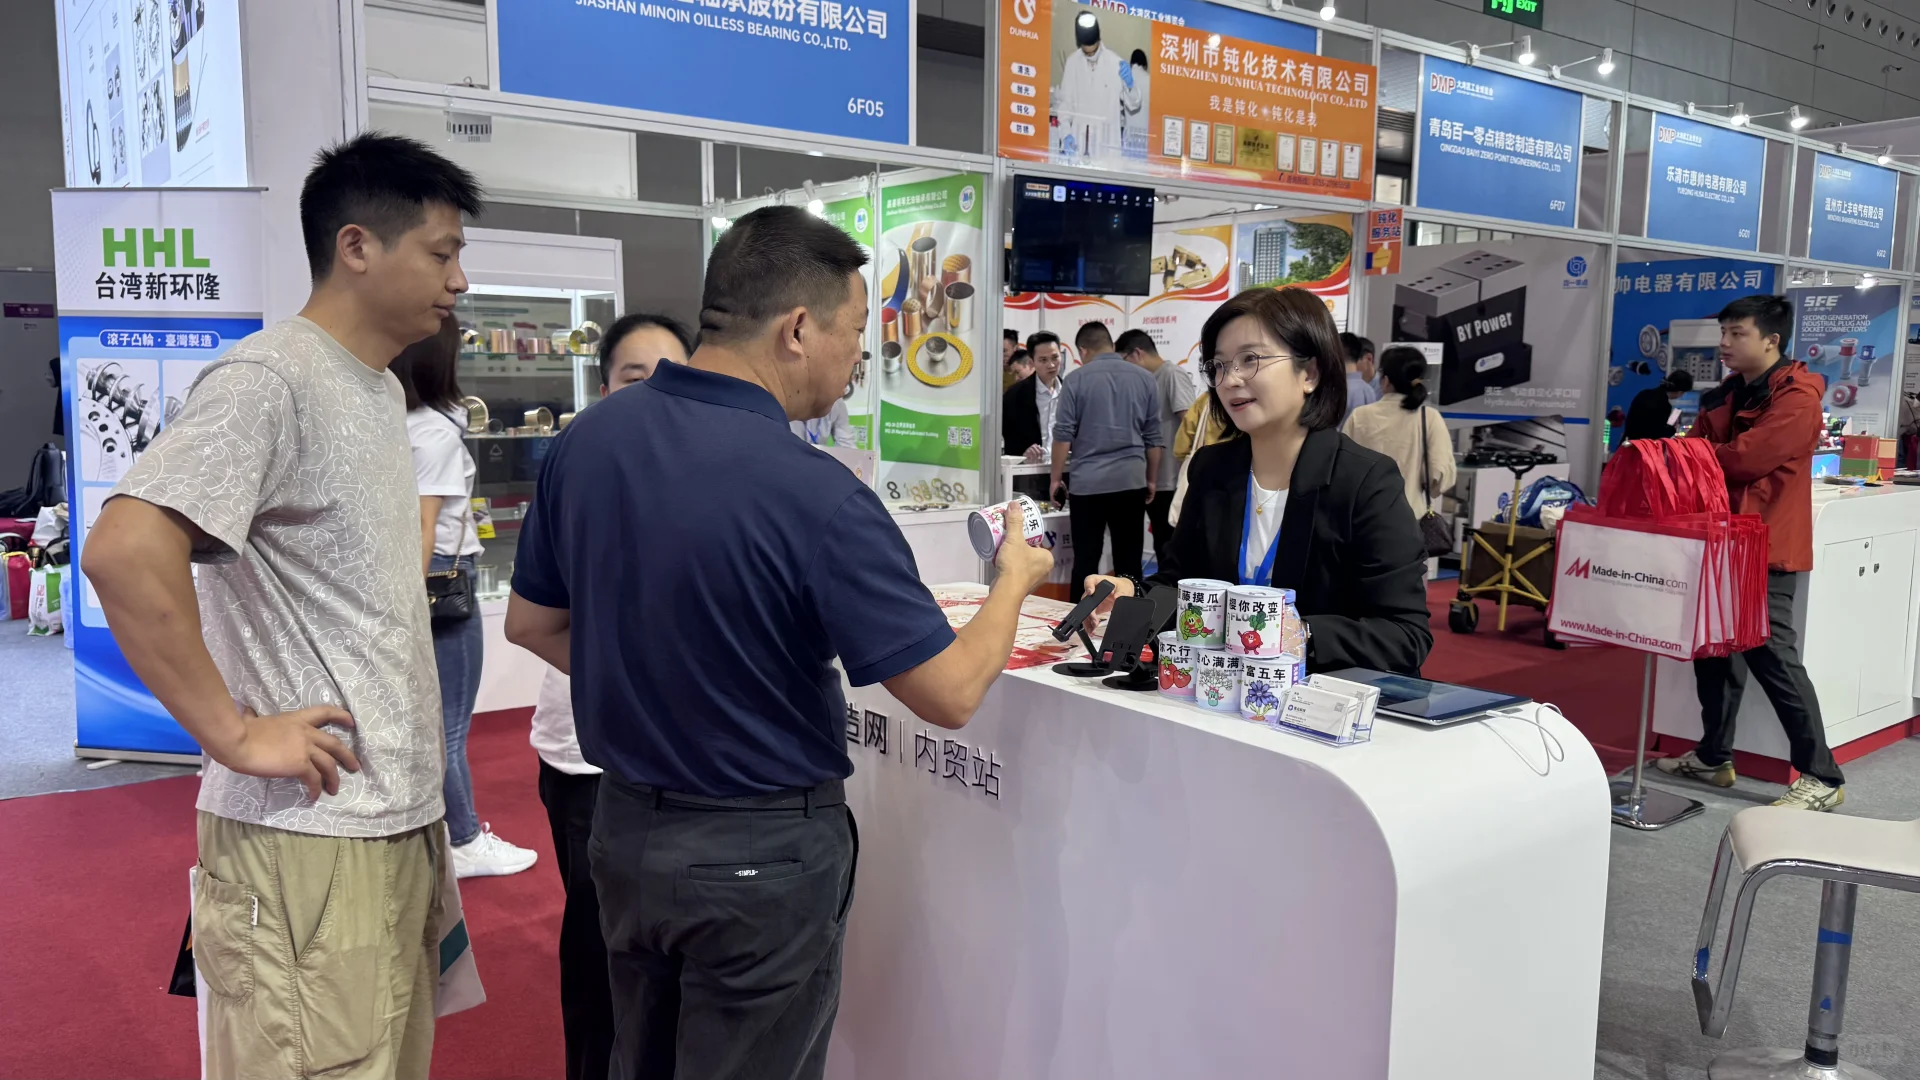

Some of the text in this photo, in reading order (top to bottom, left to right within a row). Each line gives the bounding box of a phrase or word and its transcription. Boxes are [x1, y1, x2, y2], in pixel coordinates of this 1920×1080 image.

[640, 3, 690, 23] MINQIN
[693, 12, 745, 33] OILLESS
[747, 22, 800, 42] BEARING
[803, 31, 851, 51] CO.,LTD.
[1009, 26, 1039, 41] DUNHUA
[1160, 33, 1369, 97] 深圳市钝化技术有限公司
[1160, 63, 1219, 83] SHENZHEN
[1220, 74, 1264, 92] DUNHUA
[1264, 82, 1330, 103] TECHNOLOGY
[1430, 72, 1456, 95] DMP
[847, 97, 884, 118] 6F05
[1209, 95, 1317, 127] 我是钝化 钝化是我
[1429, 117, 1573, 163] 青岛百一零点精密制造有限公司
[1658, 126, 1676, 144] DMP
[1549, 200, 1565, 212] 6F07
[103, 228, 210, 268] HHL
[95, 272, 220, 300] 台湾新环隆
[1804, 295, 1839, 307] SFE
[1456, 312, 1512, 342] BY Power
[1592, 565, 1688, 590] Made-in-China.com
[1560, 620, 1682, 652] www.Made-in-China.com
[1241, 662, 1286, 681] 富五车
[915, 729, 1002, 801] 内贸站
